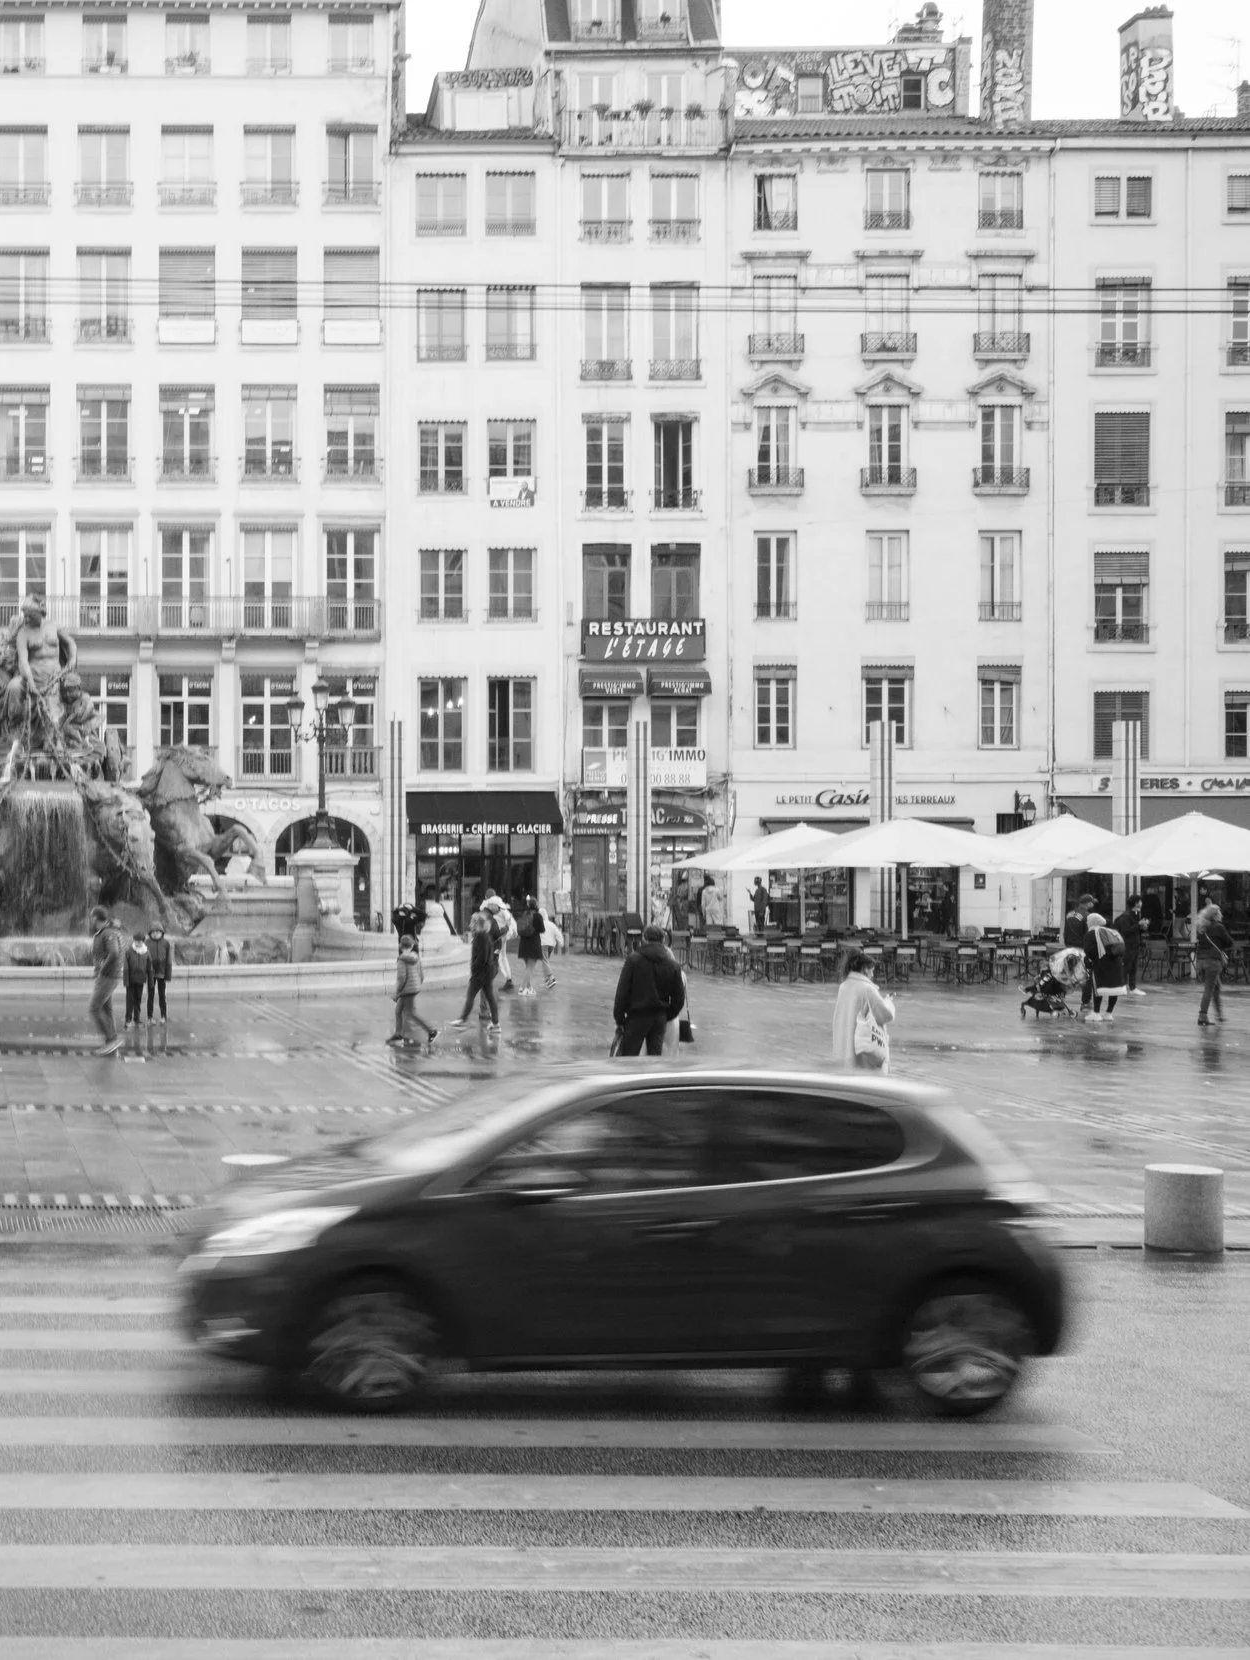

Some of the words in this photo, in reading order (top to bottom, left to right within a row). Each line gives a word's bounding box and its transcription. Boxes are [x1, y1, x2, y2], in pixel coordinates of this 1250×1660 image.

[589, 621, 704, 636] RESTAURANT
[603, 635, 686, 659] L'ÉTAGE
[612, 749, 706, 761] PRIG'IMMO
[234, 798, 301, 811] O'TACOS
[776, 795, 786, 805] LE
[788, 795, 812, 805] PETIT
[815, 789, 871, 809] Casin
[911, 795, 956, 805] TERREAUX
[586, 813, 618, 824] PRESSE
[421, 823, 464, 834] BRASSERIE
[471, 821, 510, 834] CRÊPERIE
[516, 823, 552, 834] GLACIER
